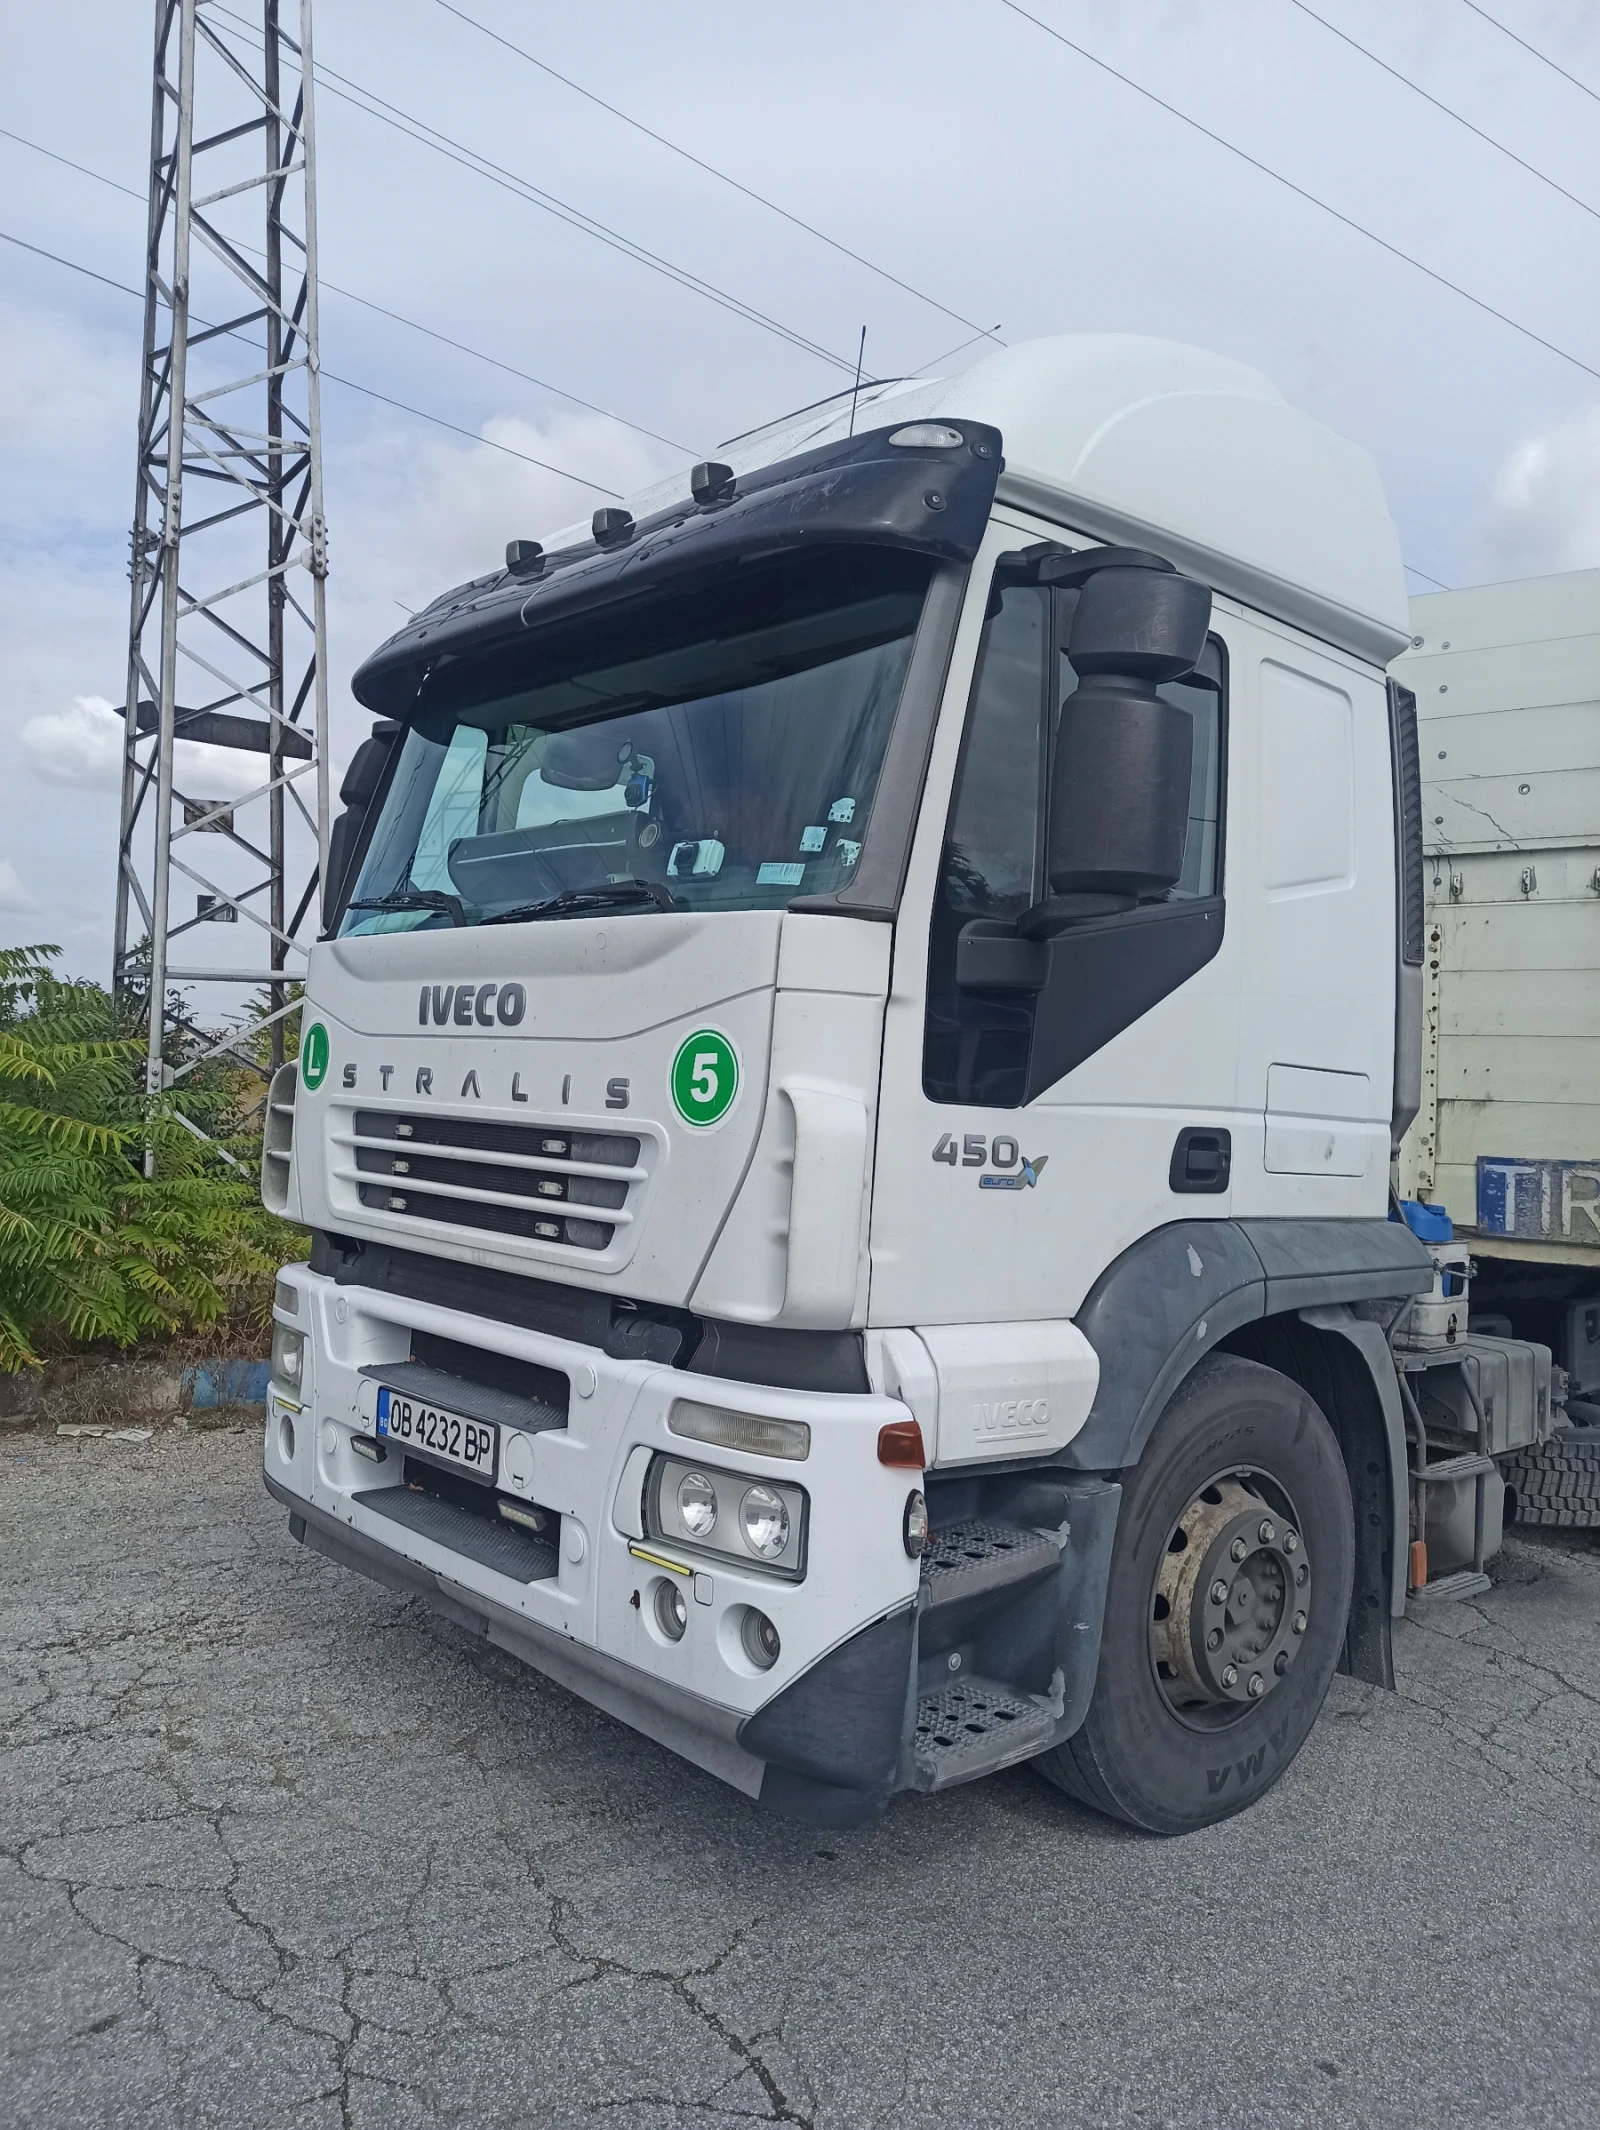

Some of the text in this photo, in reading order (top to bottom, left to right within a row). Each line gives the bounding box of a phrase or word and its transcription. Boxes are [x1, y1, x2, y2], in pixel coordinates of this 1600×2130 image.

[418, 982, 527, 1027] IVECO
[307, 1034, 322, 1077] L
[342, 1063, 631, 1110] STRALIS
[690, 1052, 720, 1104] 5
[931, 1132, 1020, 1168] 450
[983, 1177, 1015, 1186] euro
[1484, 1164, 1600, 1237] TIR
[379, 1416, 388, 1428] BG
[390, 1399, 491, 1465] OB 4232 BP
[972, 1398, 1053, 1431] IVECO
